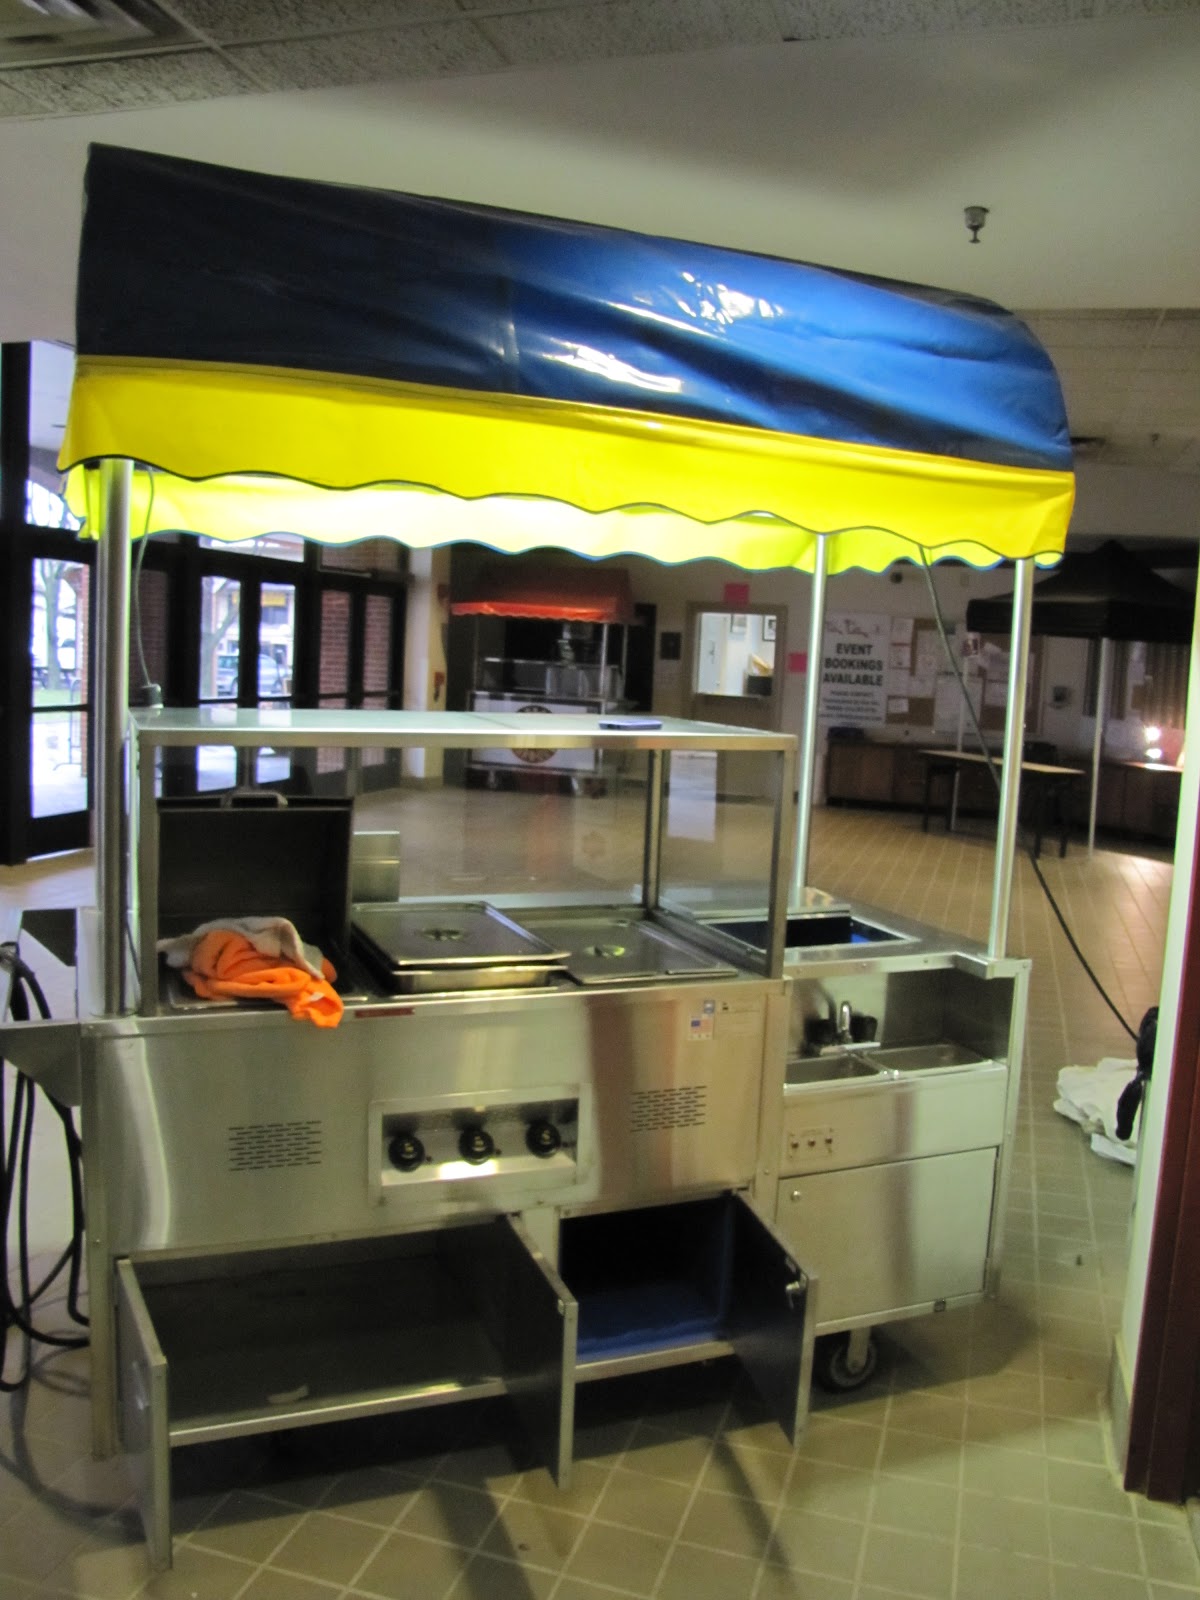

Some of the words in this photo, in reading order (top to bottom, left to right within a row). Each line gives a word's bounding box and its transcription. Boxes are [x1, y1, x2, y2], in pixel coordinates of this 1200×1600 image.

[837, 643, 873, 655] EVENT
[825, 658, 883, 671] BOOKINGS
[823, 673, 883, 686] AVAILABLE
